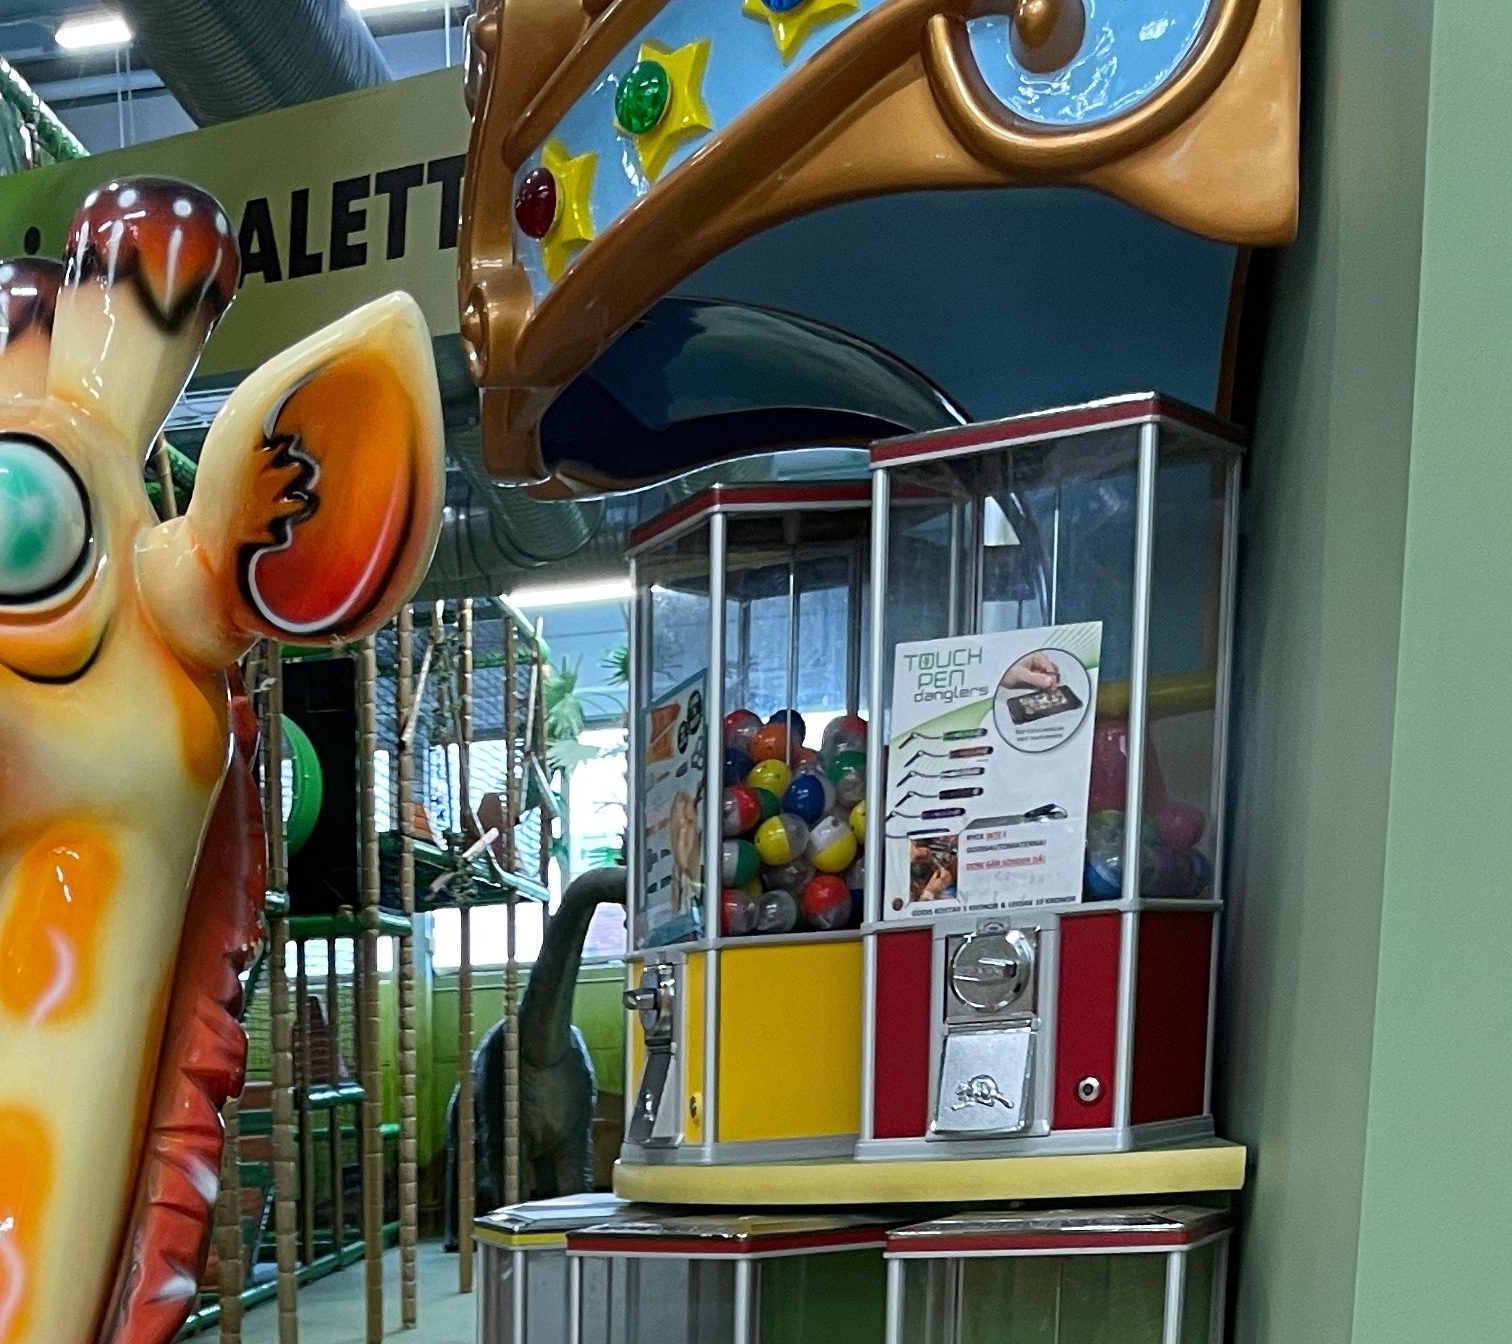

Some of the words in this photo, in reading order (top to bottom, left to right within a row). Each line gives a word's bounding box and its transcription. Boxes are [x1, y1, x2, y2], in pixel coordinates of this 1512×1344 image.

[903, 647, 983, 672] TOUCH
[918, 669, 965, 690] PEN
[914, 685, 988, 704] danglers
